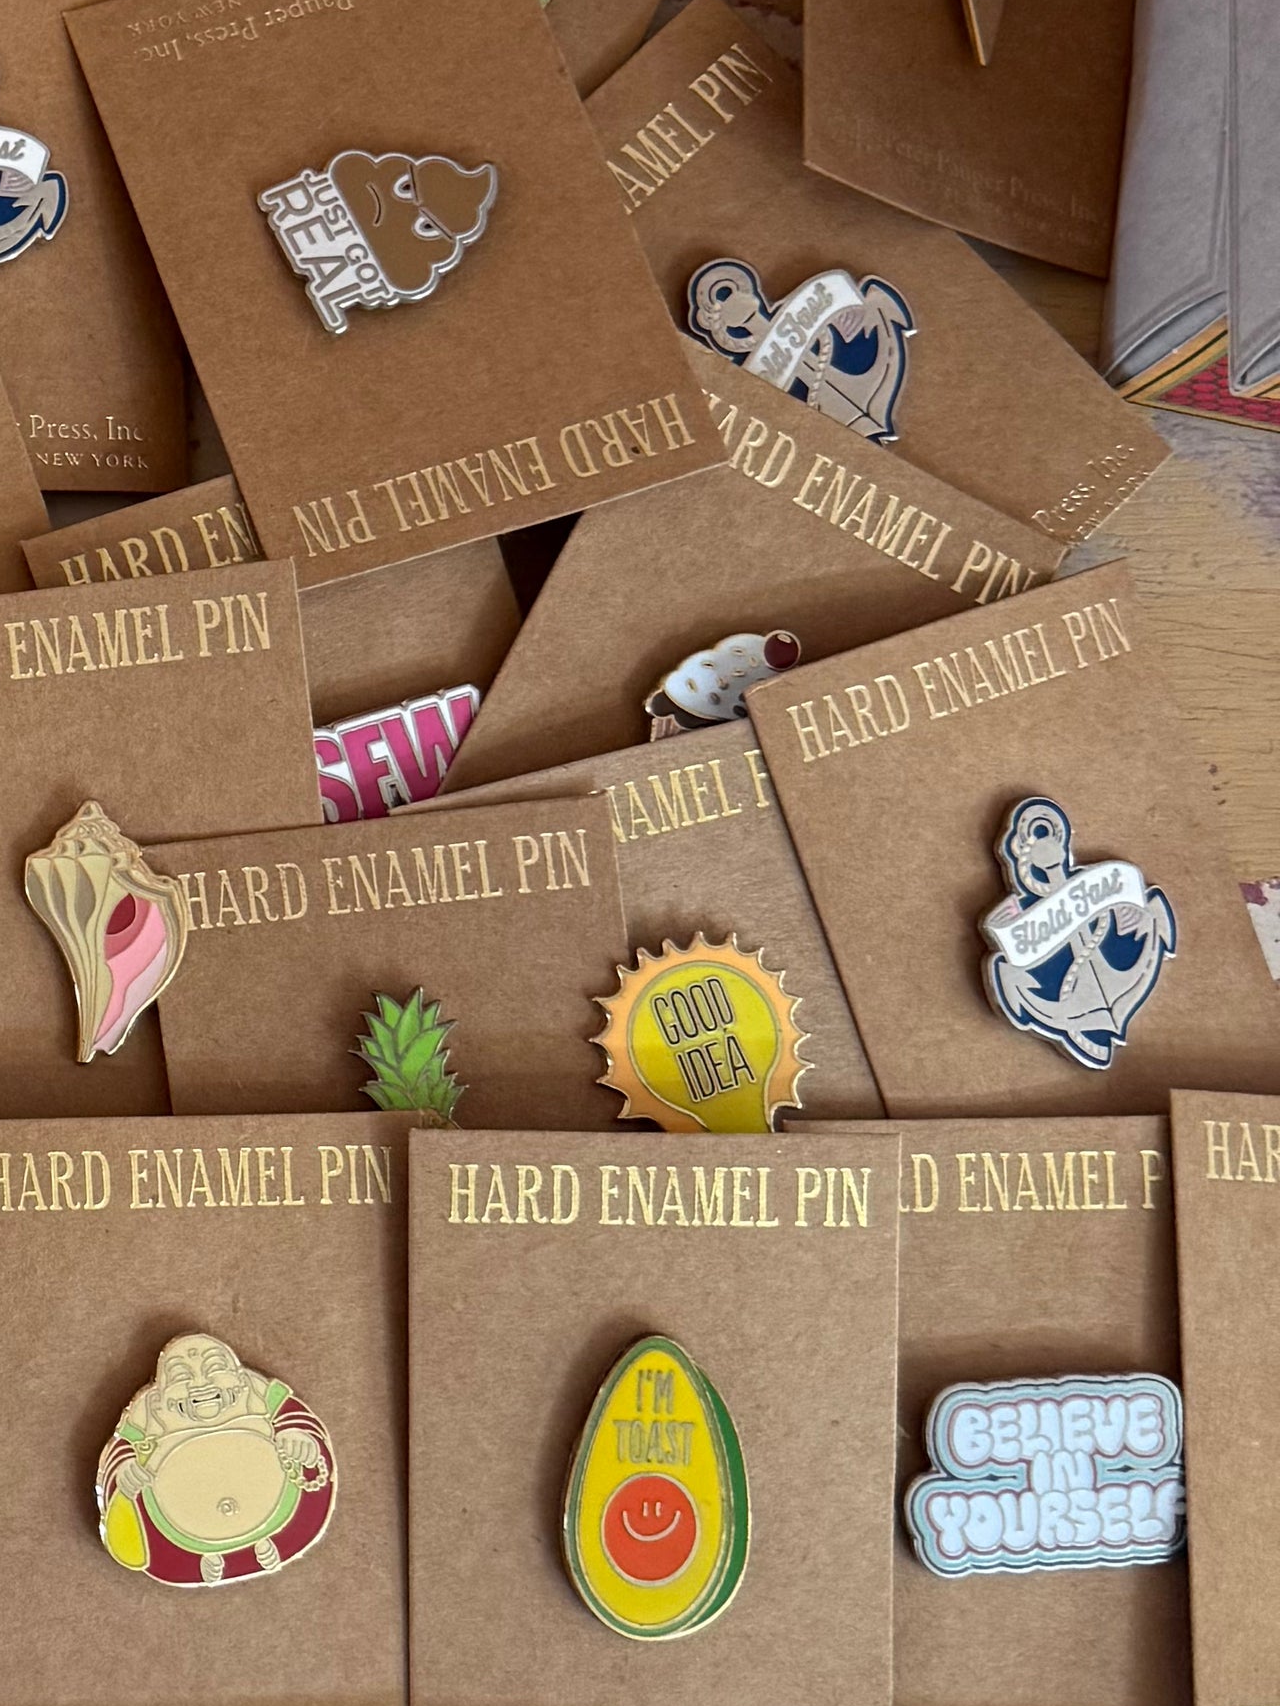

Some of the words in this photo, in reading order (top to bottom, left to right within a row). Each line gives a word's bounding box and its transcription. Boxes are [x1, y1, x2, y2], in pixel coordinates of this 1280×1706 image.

[265, 180, 363, 324] REAL
[302, 172, 358, 237] JUST
[344, 242, 391, 298] GOT
[560, 392, 696, 480] HARD
[374, 435, 557, 534] ENAMEL
[292, 489, 375, 558] PIN
[4, 603, 184, 681] ENAMEL
[190, 592, 272, 658] PIN
[786, 673, 912, 764] HARD
[912, 623, 1067, 723] ENAMEL
[1061, 597, 1132, 671] PIN
[178, 861, 309, 932] HARD
[322, 839, 504, 917] ENAMEL
[511, 828, 591, 892] PIN
[1011, 906, 1072, 955] Hold
[1068, 868, 1124, 911] Fast
[651, 976, 736, 1048] GOOD
[675, 1034, 757, 1105] IDEA
[129, 1145, 306, 1211] ENAMEL
[318, 1143, 393, 1207] PIN
[448, 1162, 581, 1227] HARD
[598, 1164, 779, 1229] ENAMEL
[793, 1164, 871, 1228] PIN
[636, 1367, 676, 1416] I'M
[614, 1418, 696, 1466] TOAST
[950, 1395, 1164, 1463] BELIEVE
[1028, 1447, 1096, 1497] IN
